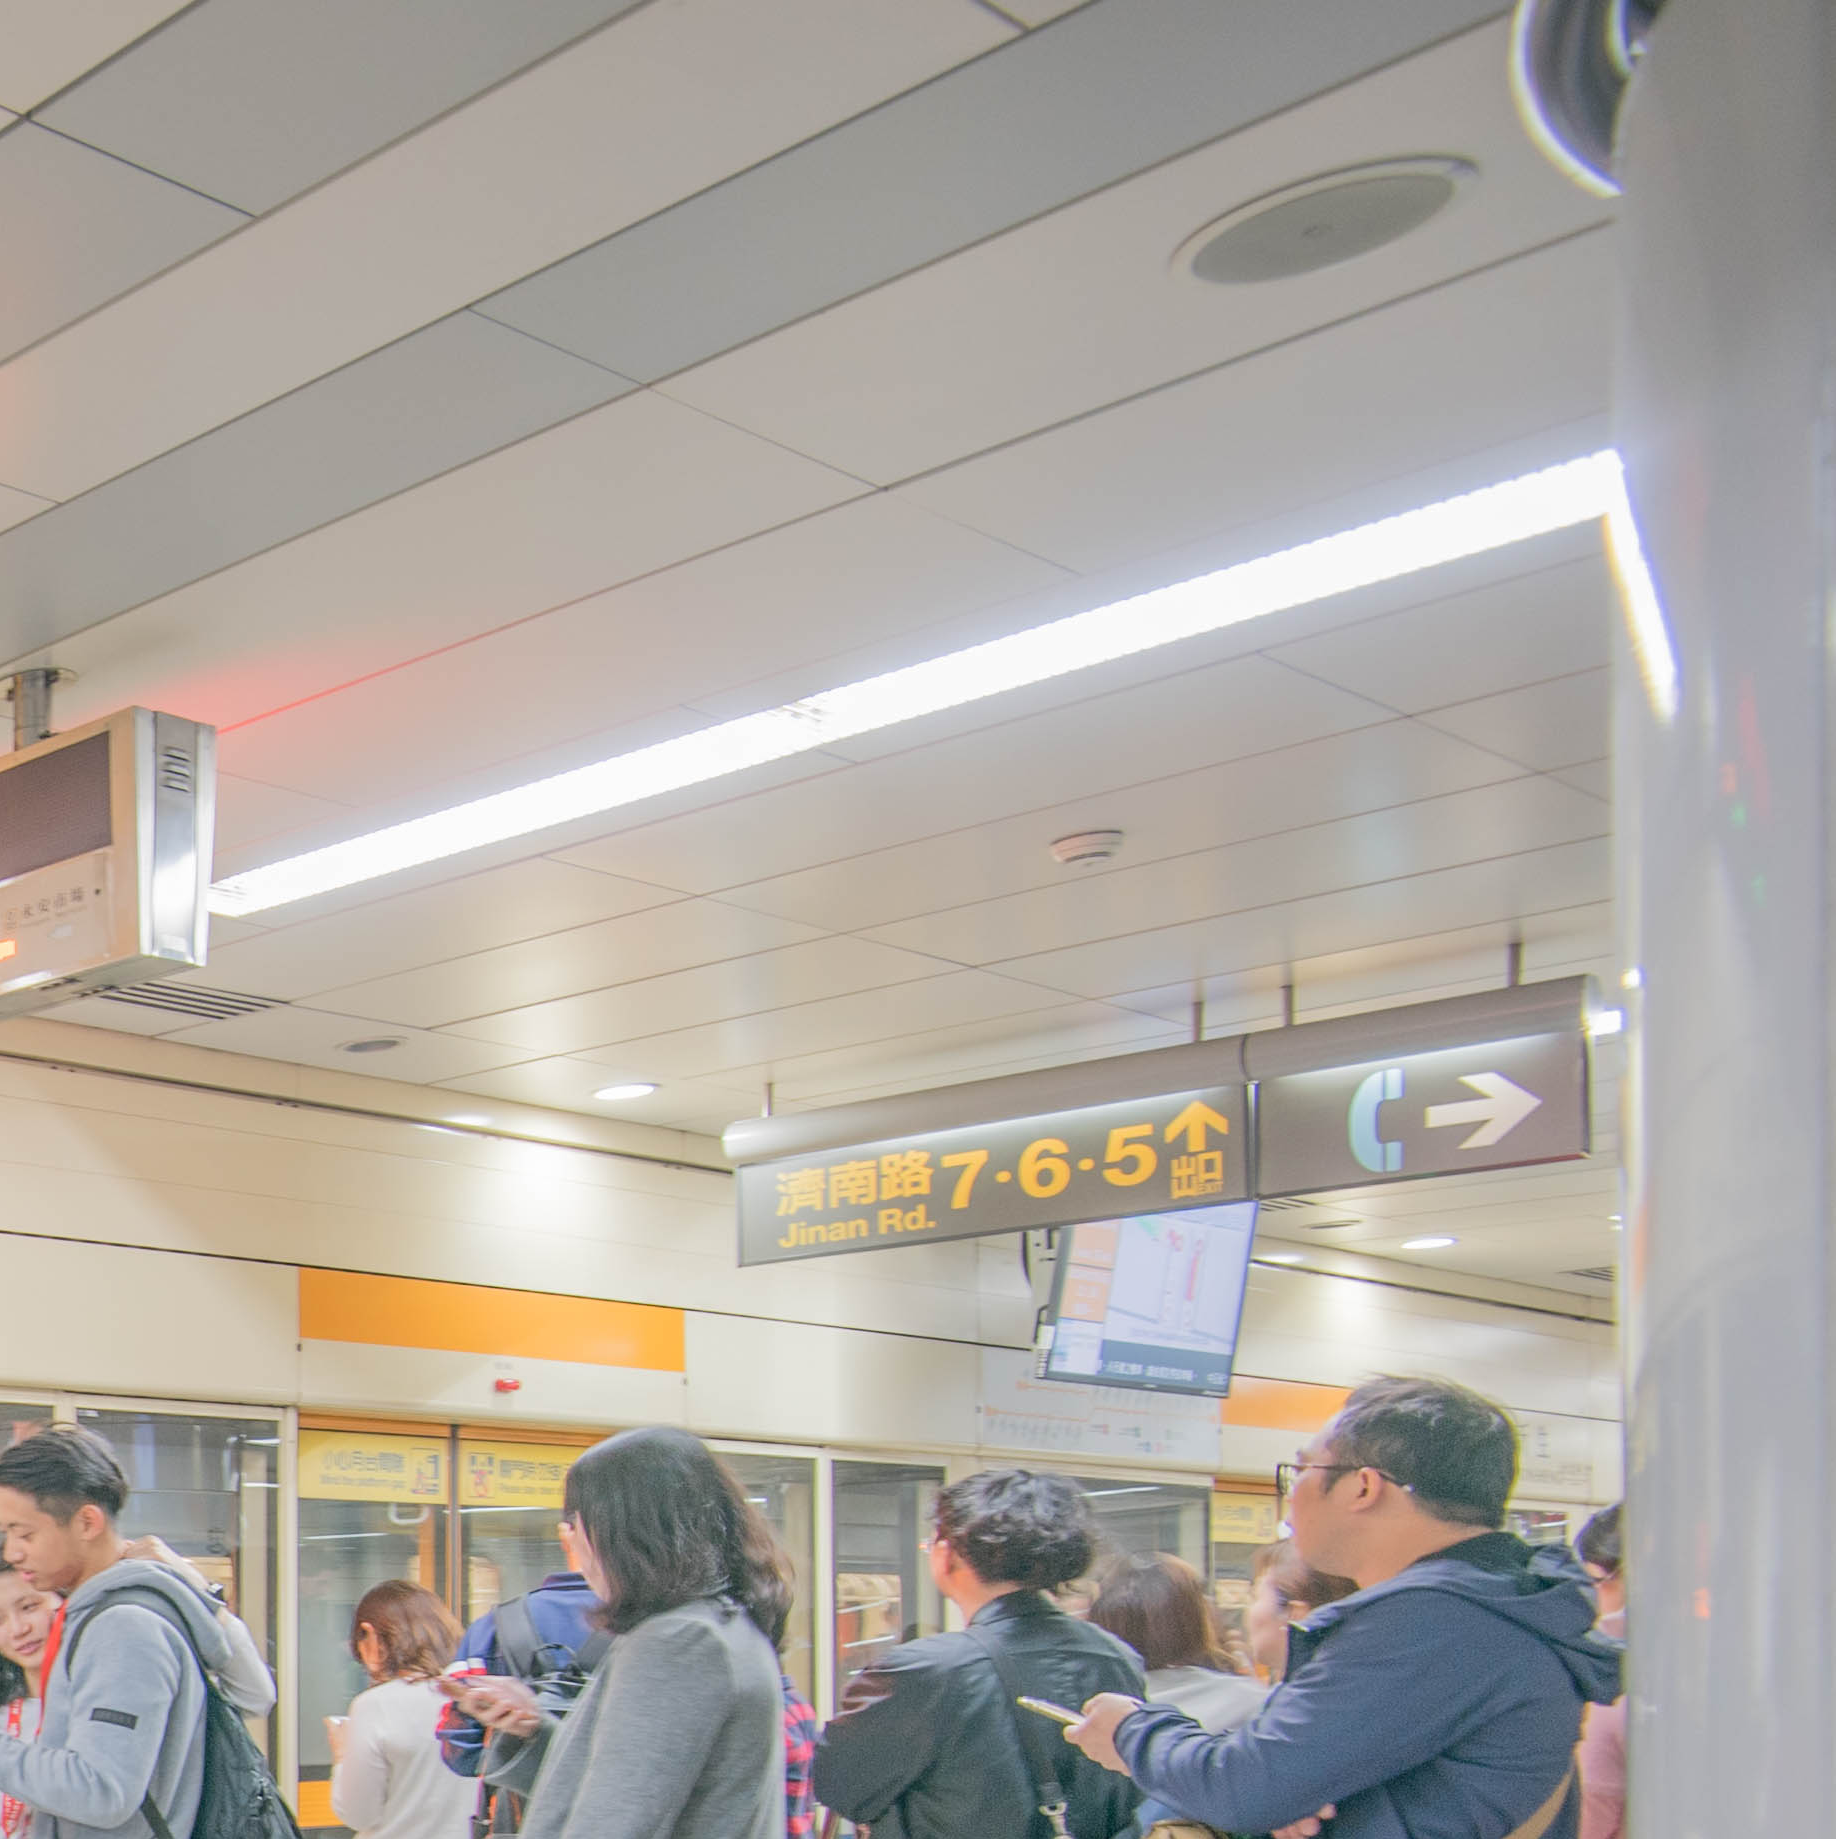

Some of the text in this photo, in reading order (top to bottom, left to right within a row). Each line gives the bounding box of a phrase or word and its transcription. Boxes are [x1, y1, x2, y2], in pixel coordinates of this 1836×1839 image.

[775, 1150, 934, 1217] 濟南路
[1170, 1150, 1224, 1200] 出口
[778, 1203, 937, 1250] Jinan Rd.
